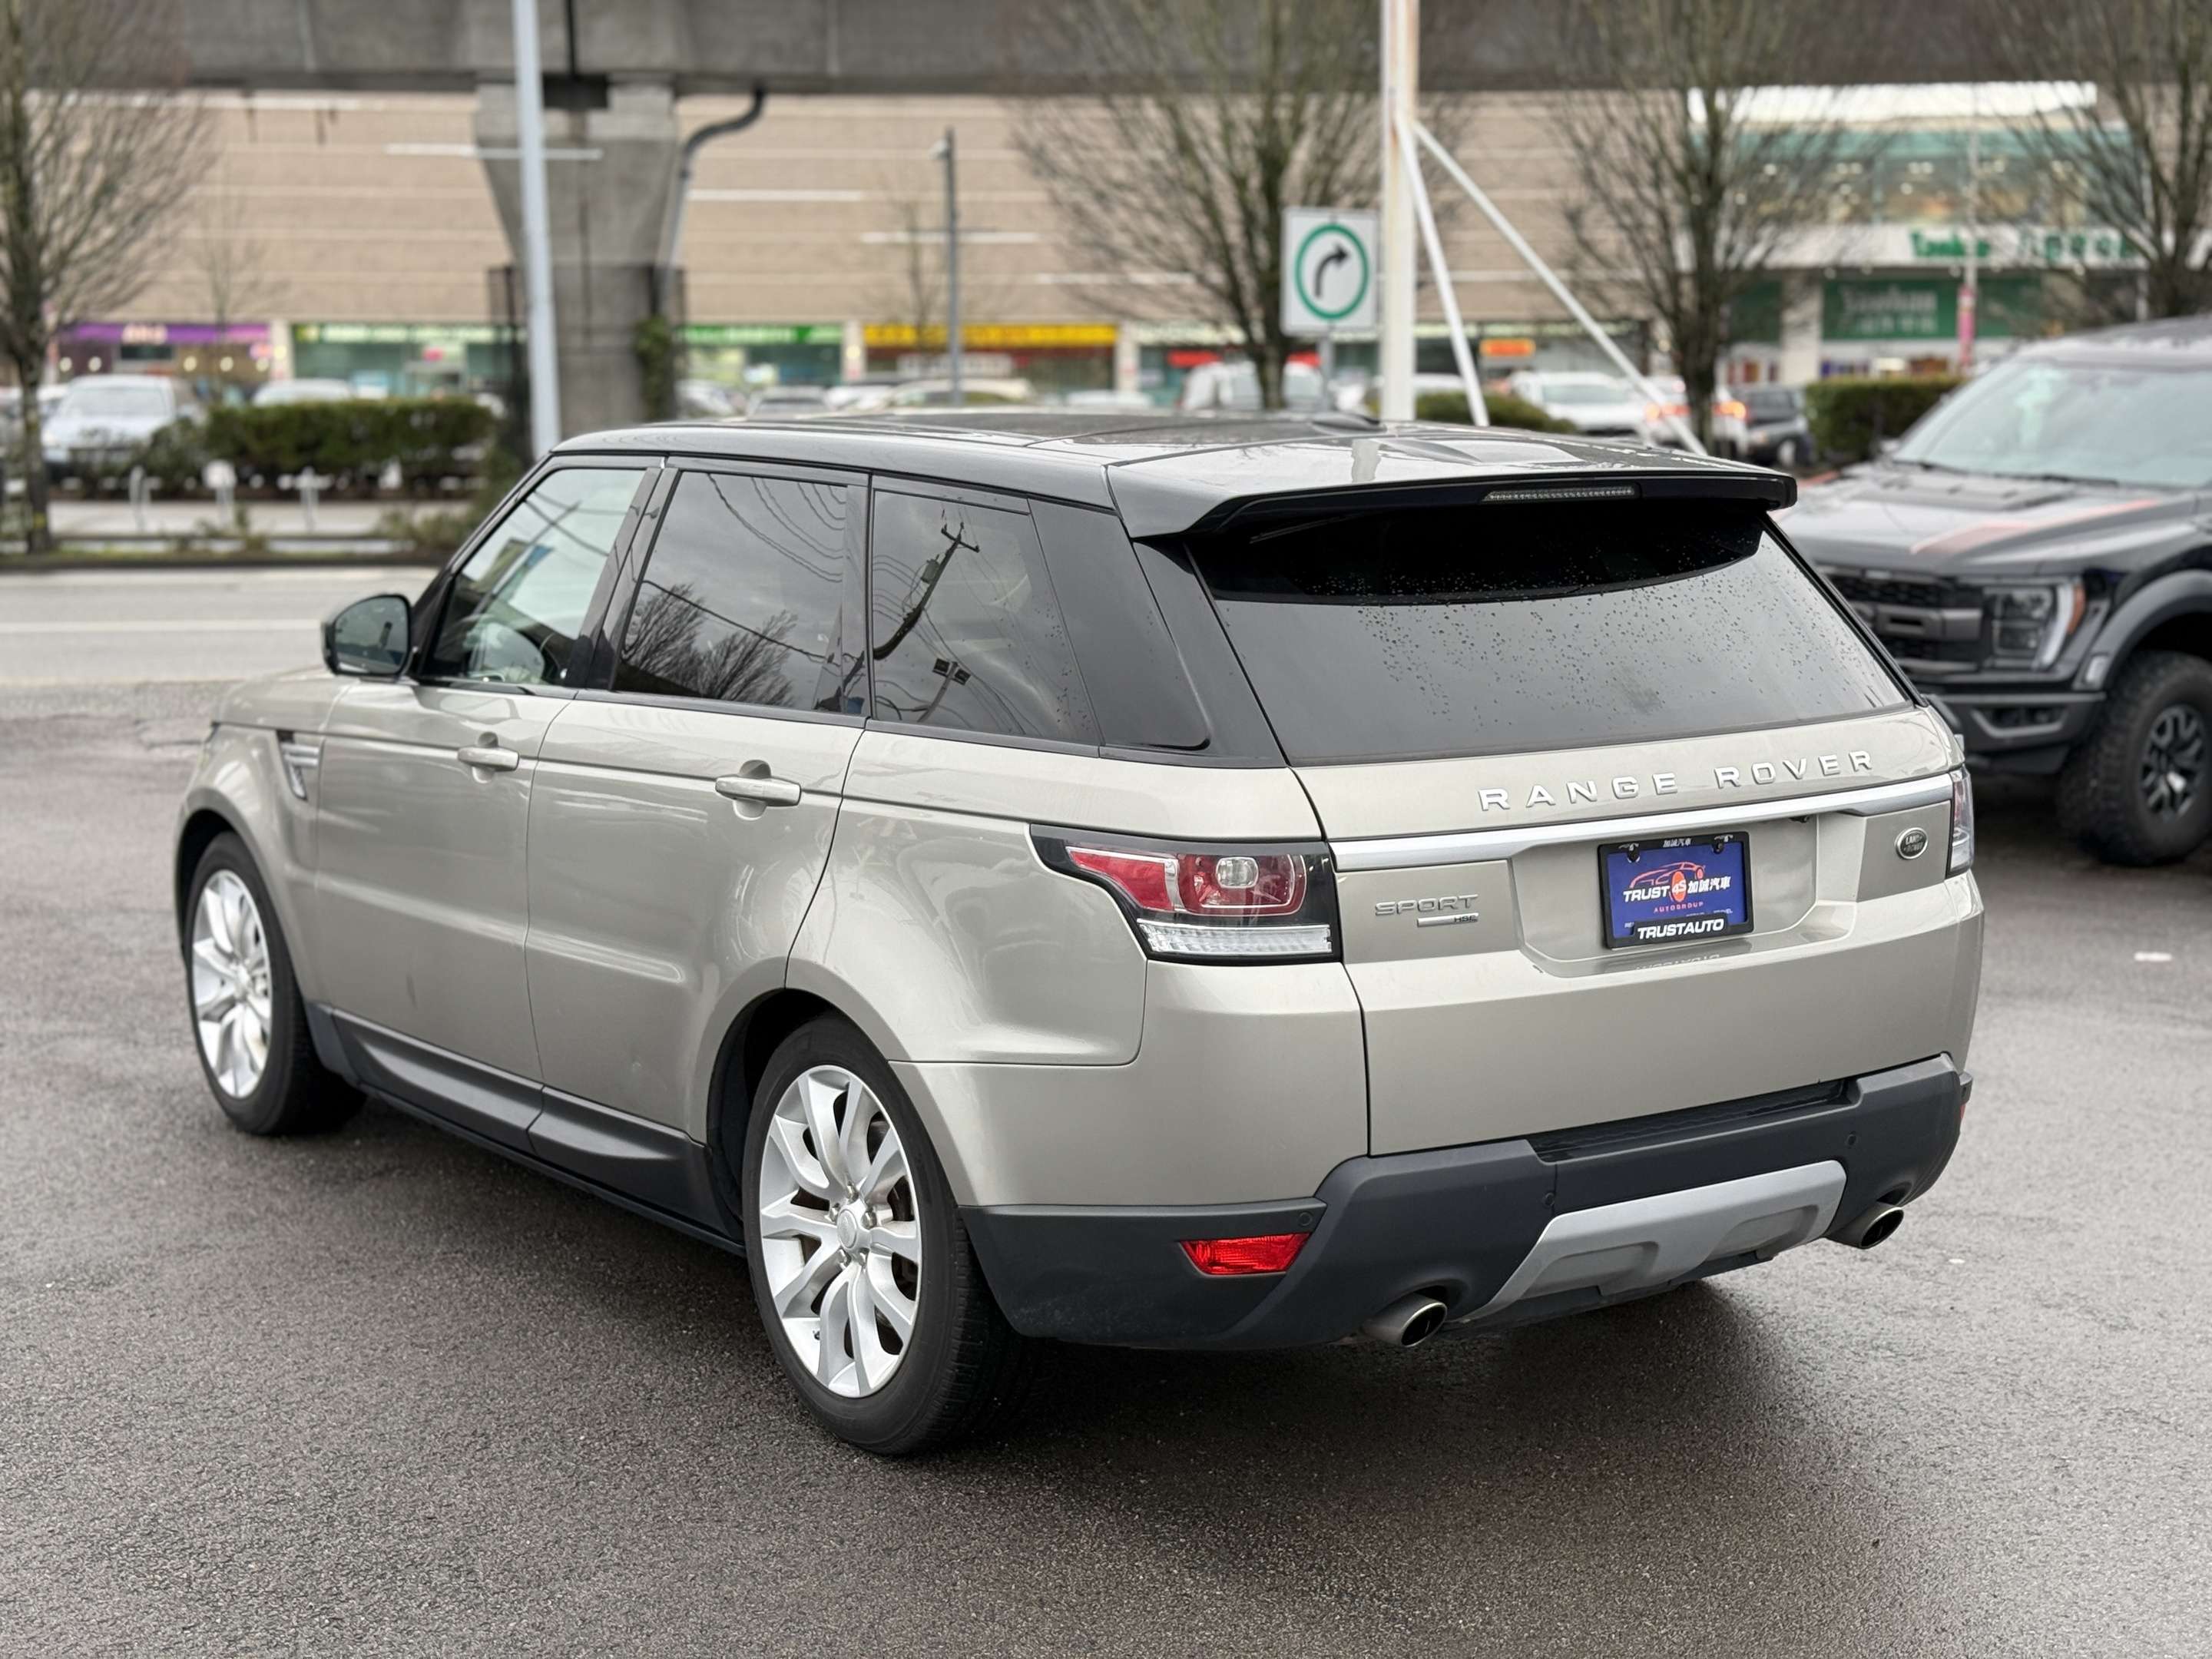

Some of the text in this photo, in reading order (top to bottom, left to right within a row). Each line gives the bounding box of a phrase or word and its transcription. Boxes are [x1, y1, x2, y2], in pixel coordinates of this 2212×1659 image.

[1478, 750, 1873, 811] RANGE ROVER
[1623, 886, 1671, 902] TRUST
[1376, 893, 1479, 916] SPORT
[1654, 902, 1704, 913] AUTOGROUP
[1637, 919, 1724, 939] TRUSTAUTO
